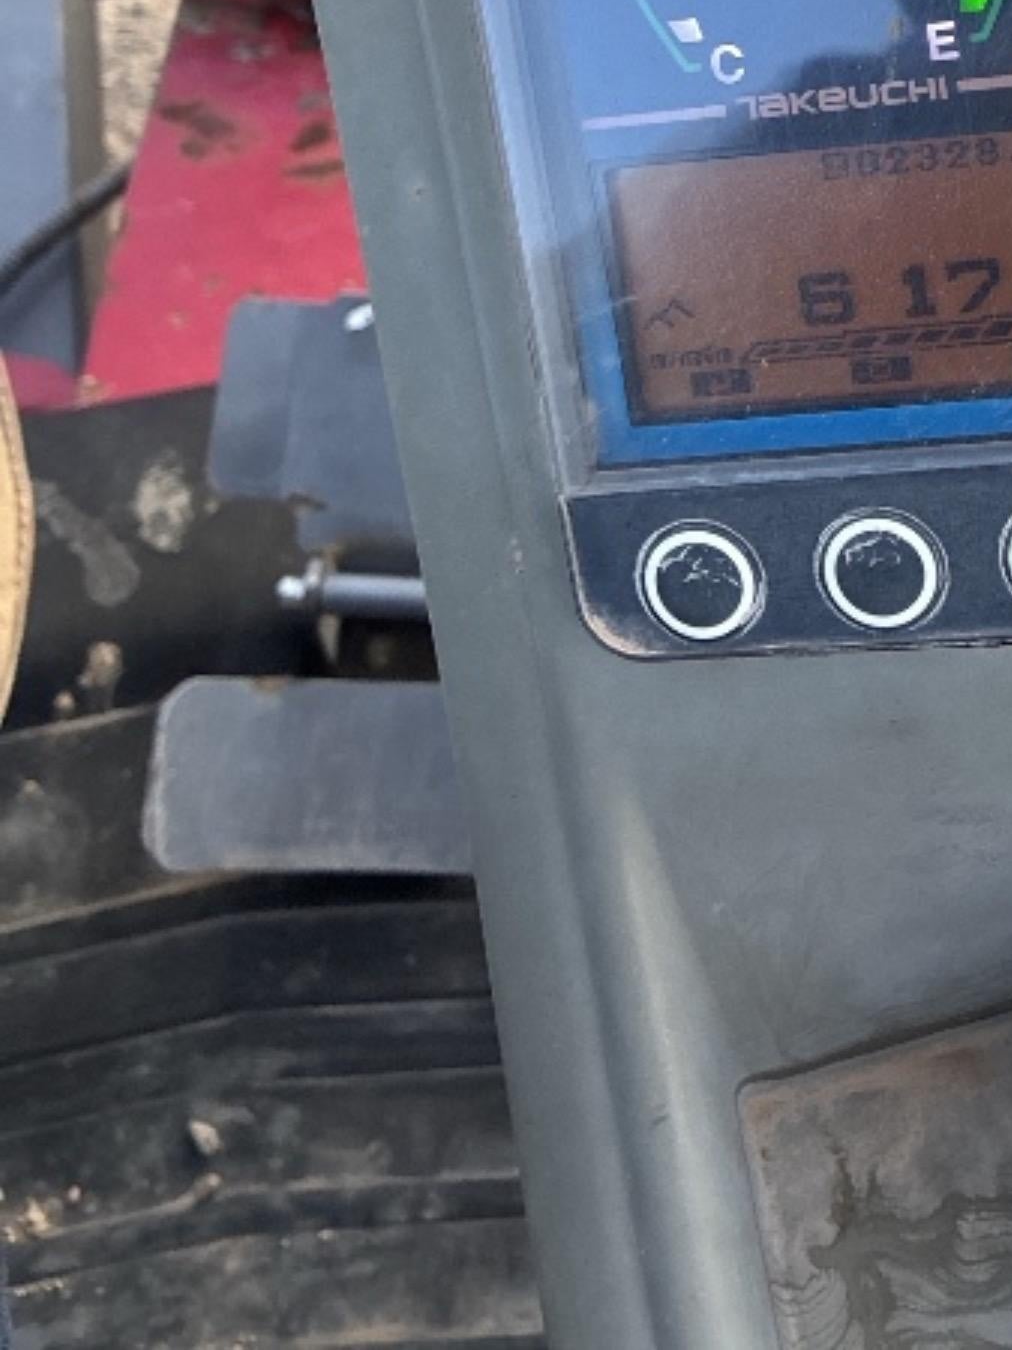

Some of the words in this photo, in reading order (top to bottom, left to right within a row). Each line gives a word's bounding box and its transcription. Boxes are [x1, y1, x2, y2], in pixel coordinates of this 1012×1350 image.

[926, 20, 959, 61] E
[709, 44, 745, 84] C
[902, 256, 1001, 319] 17
